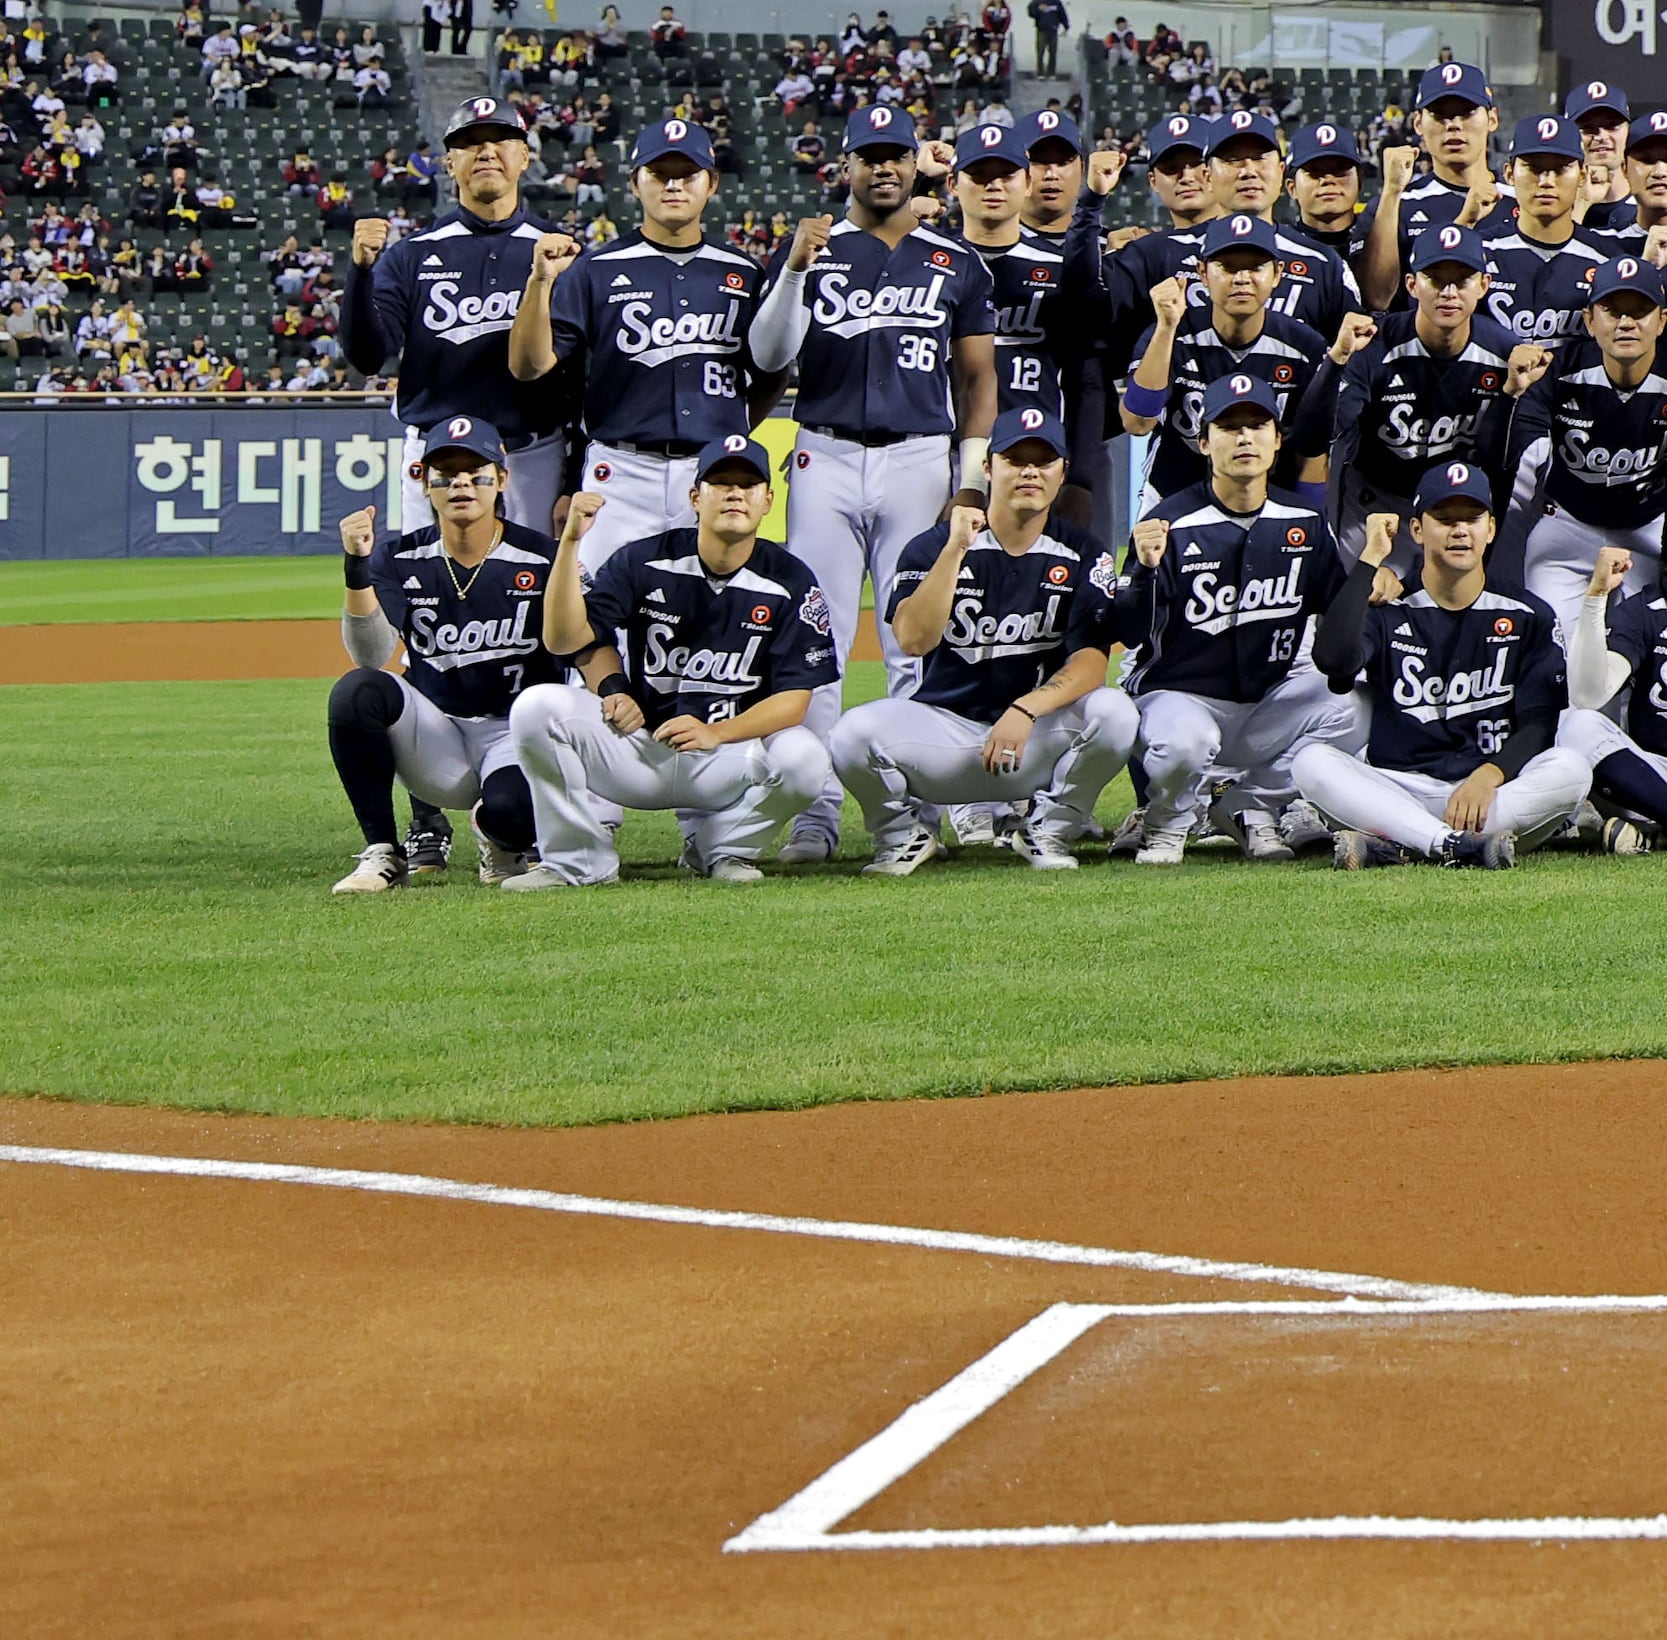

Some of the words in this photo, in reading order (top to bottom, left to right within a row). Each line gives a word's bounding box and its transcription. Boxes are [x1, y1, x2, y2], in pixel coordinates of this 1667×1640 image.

[474, 97, 496, 119] D
[870, 106, 892, 131] D
[664, 119, 688, 142] D
[980, 126, 1003, 148] D
[418, 271, 461, 280] DOOSAN
[608, 292, 652, 303] DOOSAN
[814, 275, 946, 326] Seoul
[616, 299, 742, 354] Seoul
[897, 333, 939, 373] 36
[703, 361, 738, 399] 63
[1010, 357, 1042, 393] 12
[449, 417, 472, 440] D
[1020, 409, 1044, 431] D
[724, 434, 747, 453] D
[1446, 462, 1469, 487] D
[1181, 561, 1221, 573] DOOSAN
[1185, 557, 1306, 624] Seoul
[411, 601, 538, 656] Seoul
[944, 595, 1063, 646] Seoul
[644, 624, 762, 683] Seoul
[1267, 629, 1296, 662] 13
[1391, 640, 1427, 656] DOOSAN
[504, 664, 524, 694] 7
[1393, 647, 1513, 706] Seoul
